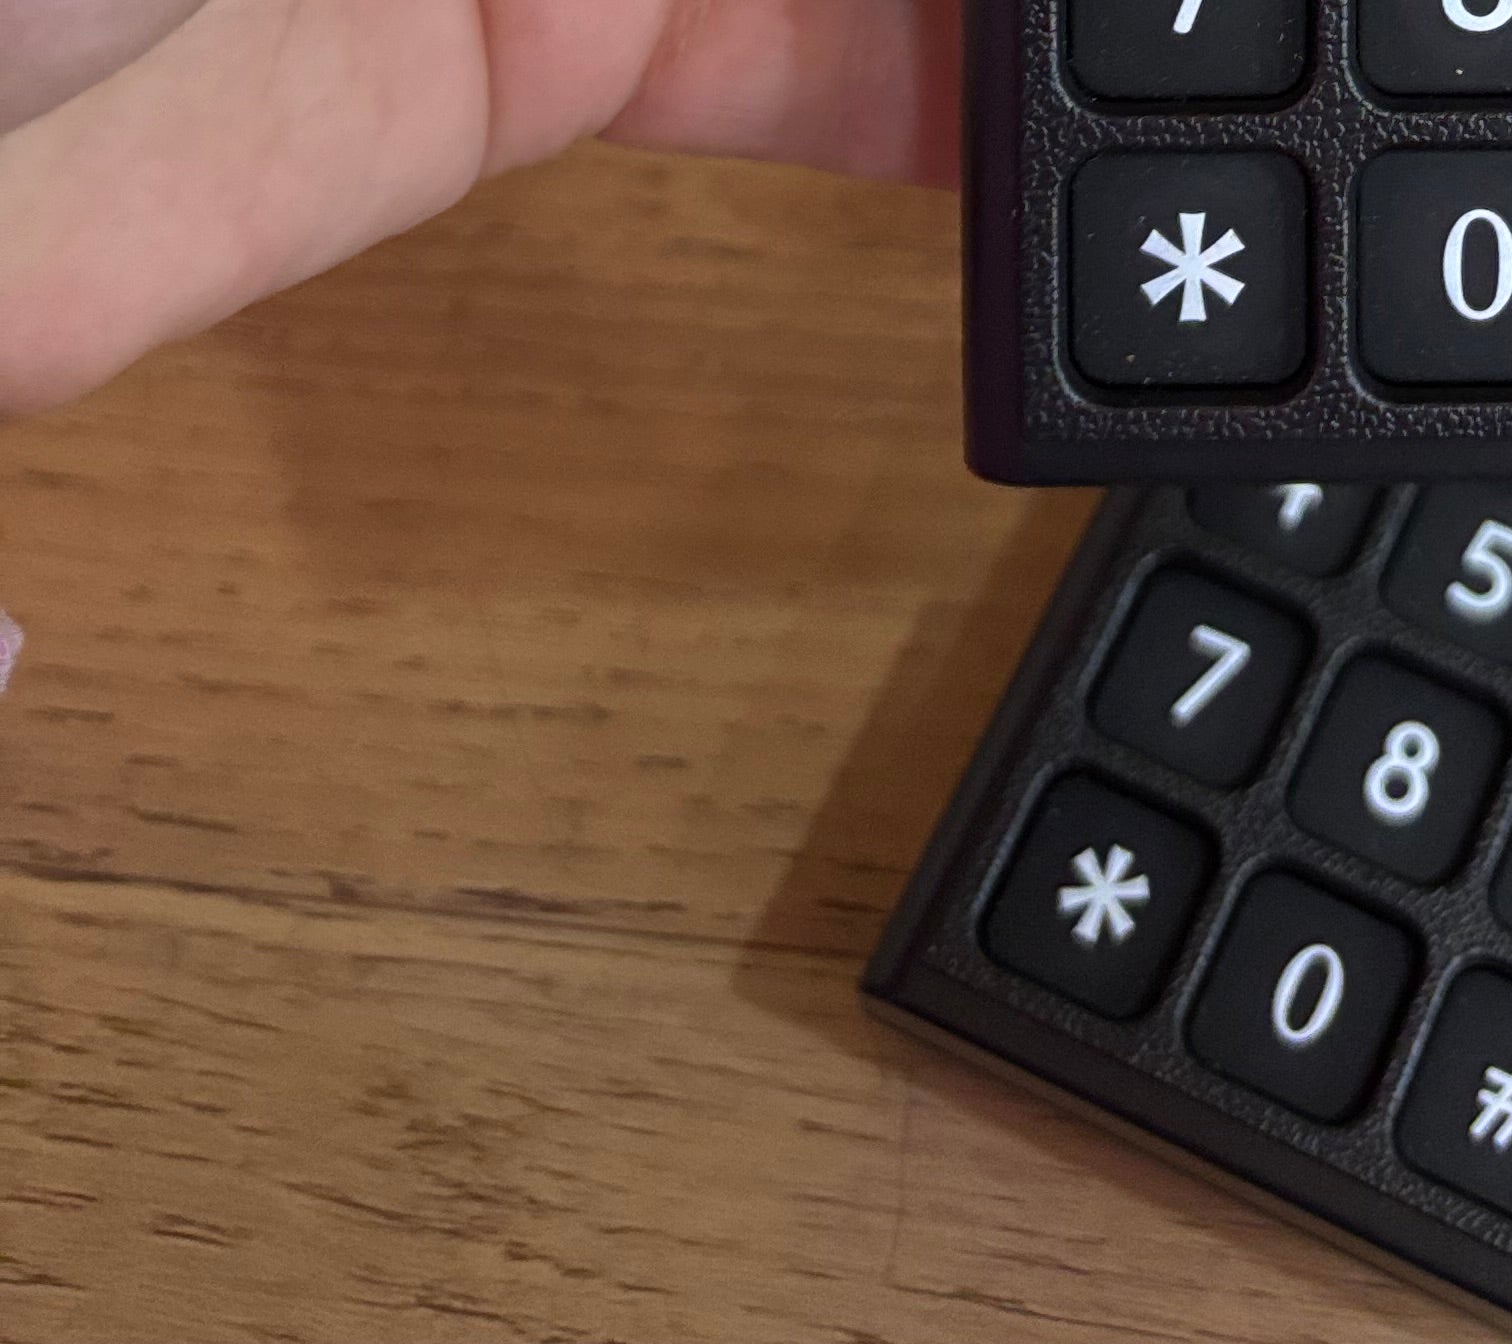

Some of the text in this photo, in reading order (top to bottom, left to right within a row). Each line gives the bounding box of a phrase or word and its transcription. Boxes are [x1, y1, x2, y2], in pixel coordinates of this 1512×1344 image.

[1169, 623, 1252, 722] 7
[1363, 719, 1442, 823] 8
[1271, 942, 1346, 1046] 0
